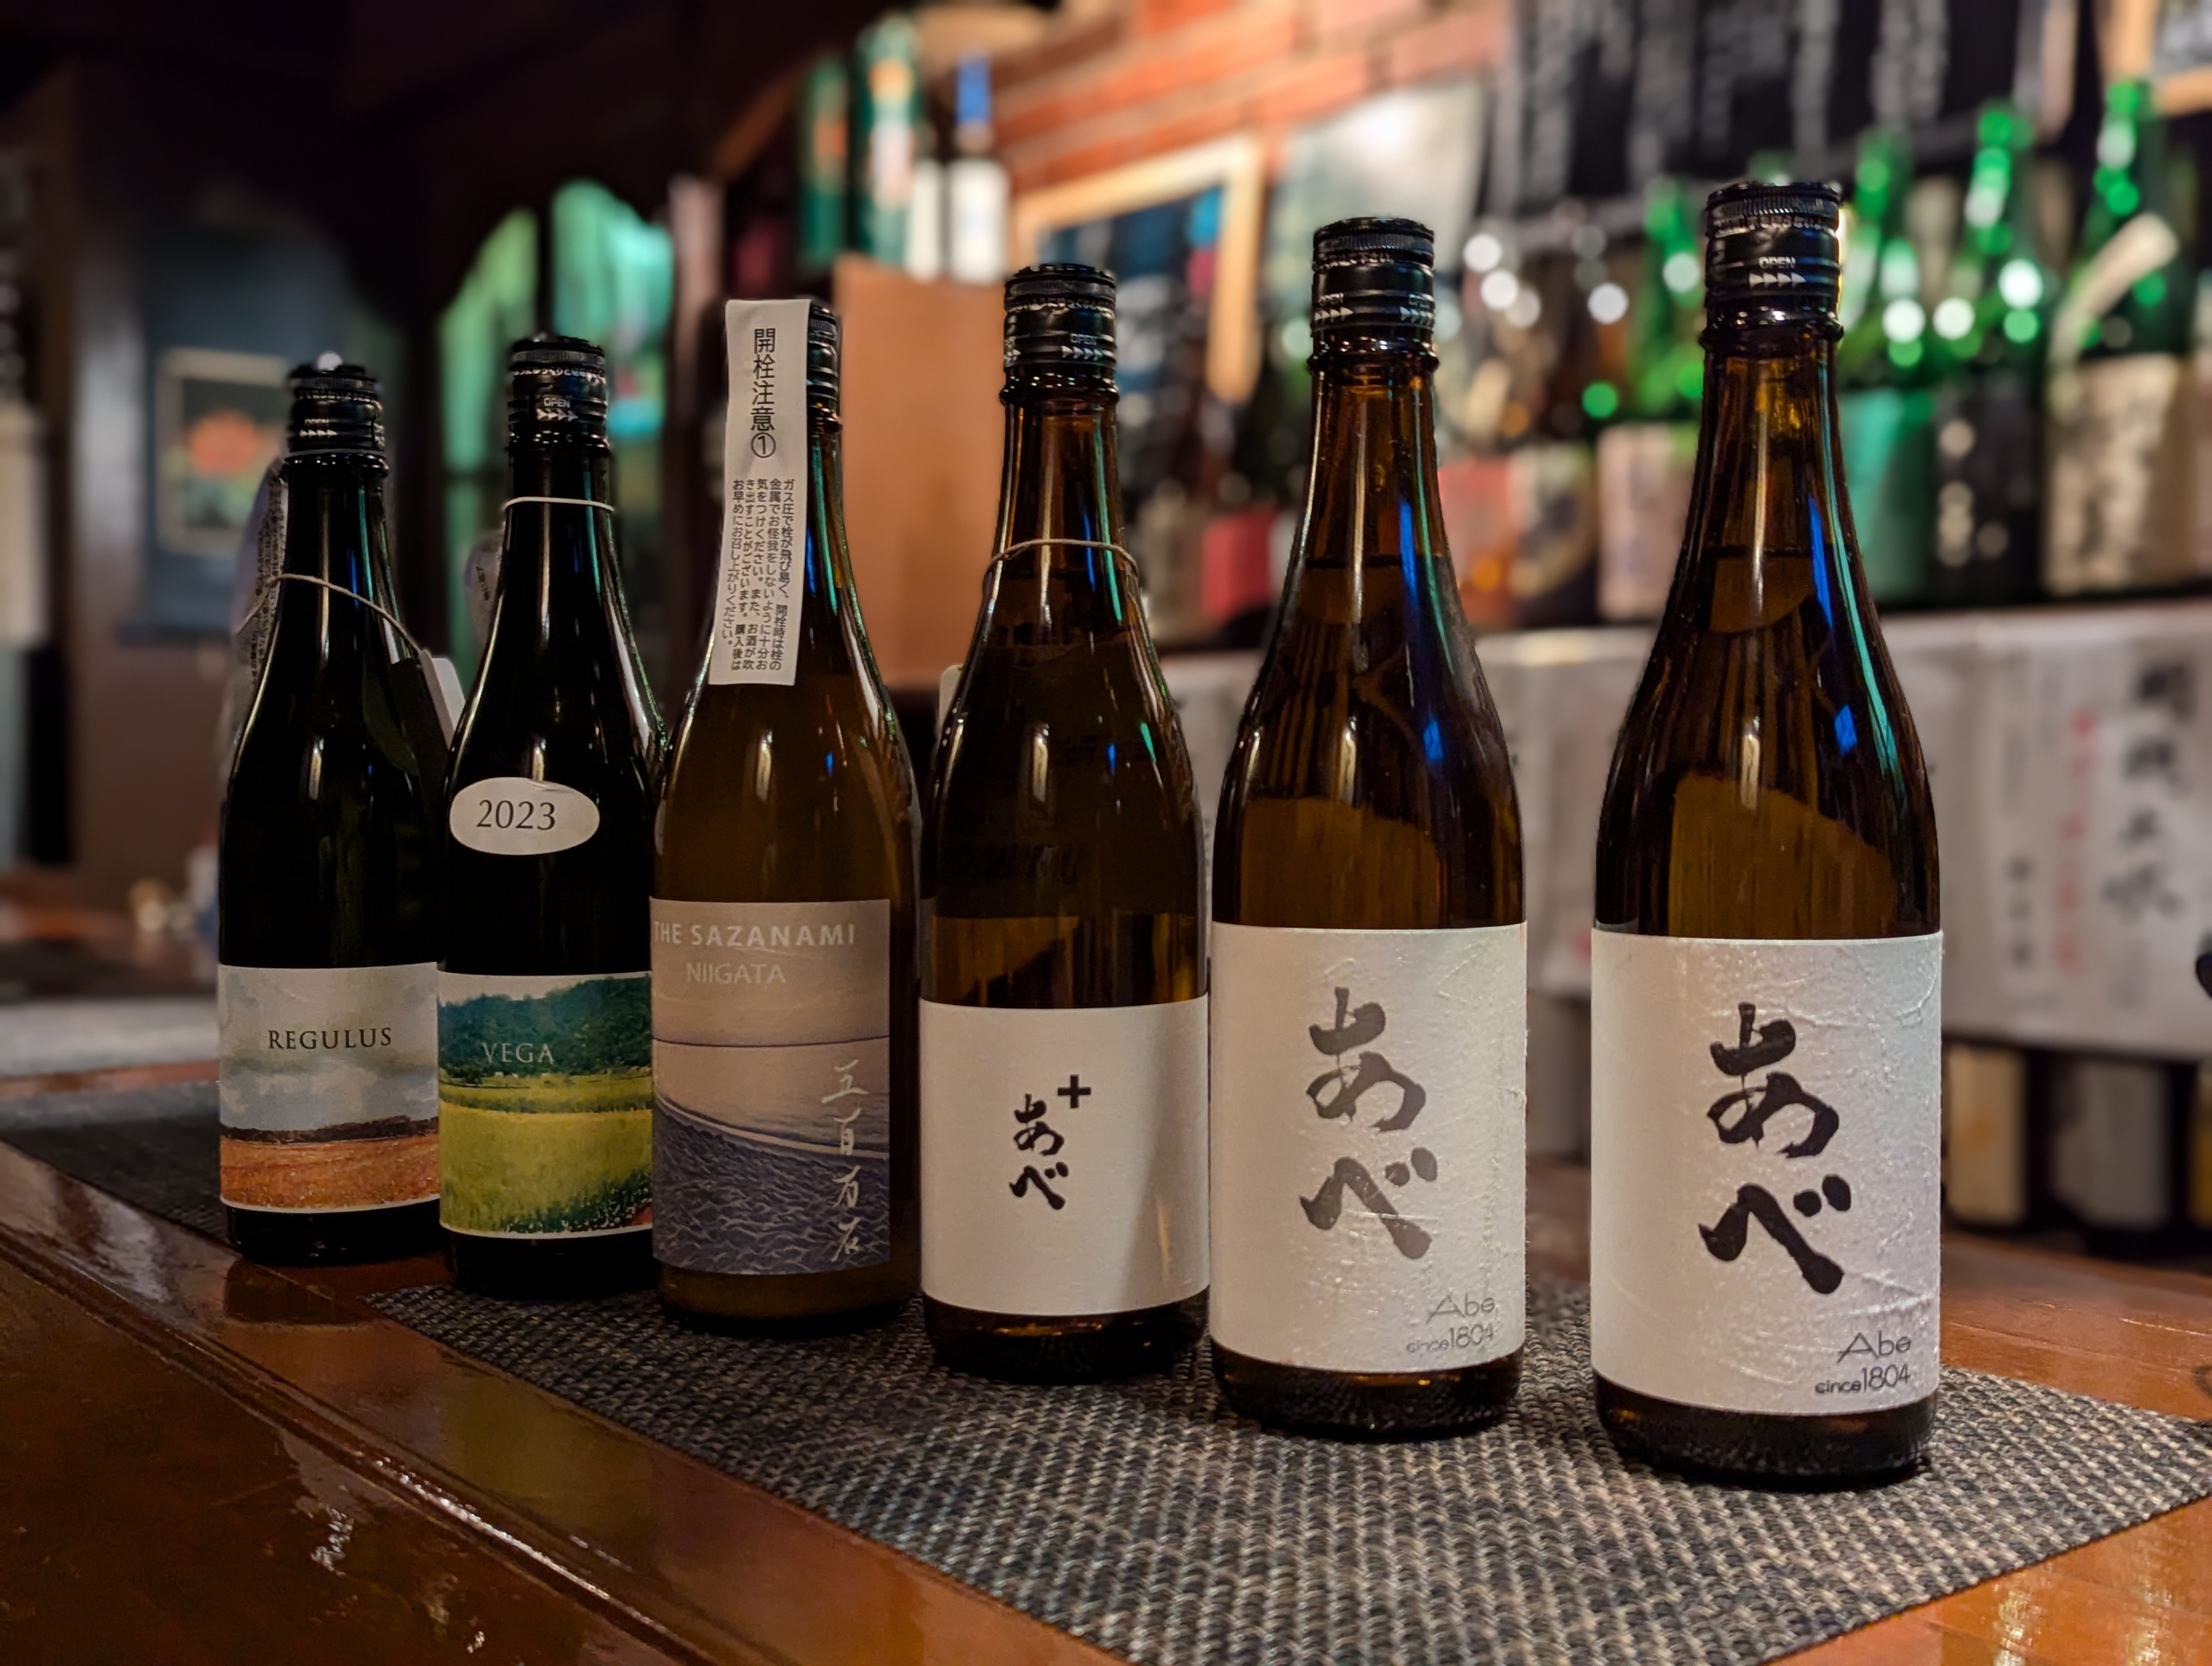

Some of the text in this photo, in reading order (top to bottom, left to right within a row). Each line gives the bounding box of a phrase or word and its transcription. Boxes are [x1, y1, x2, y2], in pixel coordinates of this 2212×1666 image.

[1759, 256, 1796, 269] OPEN
[476, 799, 556, 831] 2023
[654, 921, 855, 947] THE SAZANAMI
[686, 962, 786, 985] NIIGATA
[268, 1027, 392, 1051] REGULUS
[481, 1042, 556, 1065] VEGA
[1299, 986, 1438, 1260] あべ
[1008, 1093, 1069, 1210] あべ
[1697, 1002, 1851, 1295] あべ
[1425, 1292, 1495, 1324] Abe
[1836, 1329, 1912, 1364] Abe
